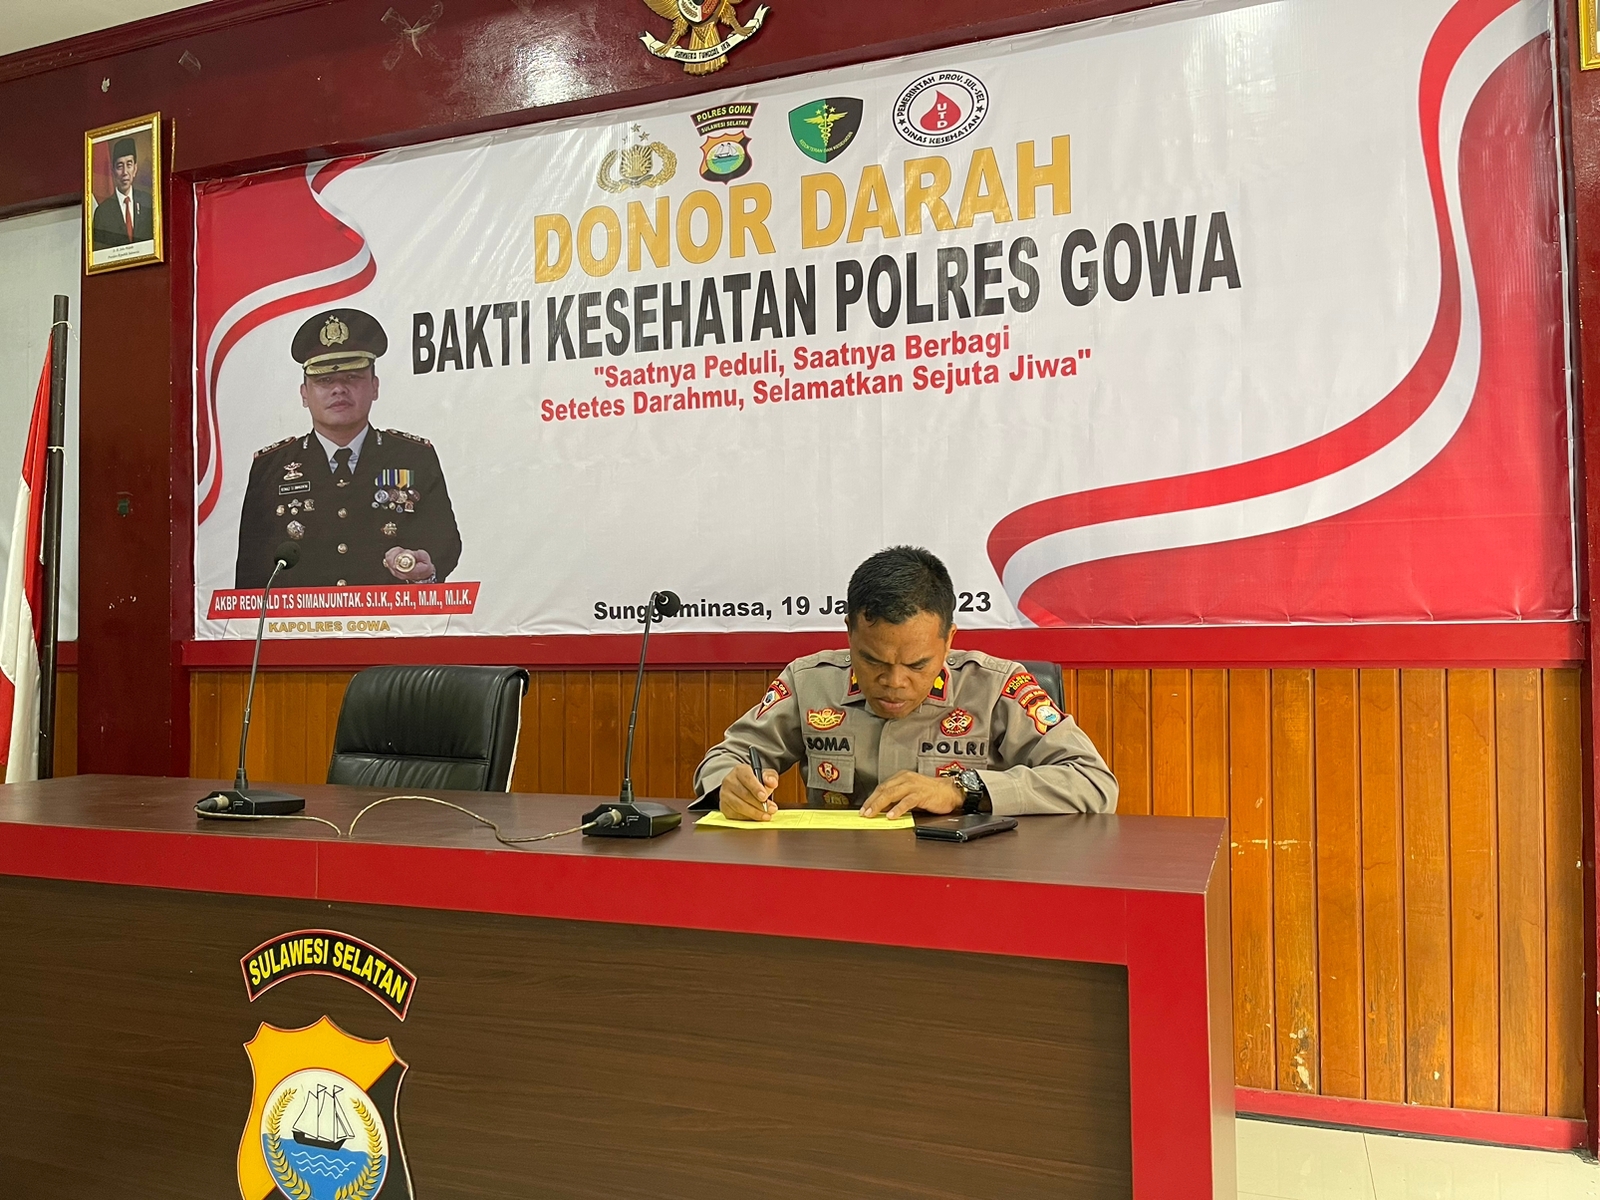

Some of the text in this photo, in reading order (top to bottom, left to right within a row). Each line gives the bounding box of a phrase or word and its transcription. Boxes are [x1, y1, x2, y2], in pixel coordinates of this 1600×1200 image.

[897, 73, 986, 117] PEMERINTAH PROV. SUL-SEL
[696, 105, 753, 122] POLRES GOWA
[701, 122, 727, 134] SULAWESI
[902, 115, 981, 145] DINAS KESEHATAN
[534, 134, 1072, 284] DONOR DARAH
[412, 211, 1242, 375] BAKTI KESEHATAN POLRES GOWA
[594, 325, 1010, 389] "Saatnya Peduli, Saatnya Berbagi
[541, 349, 1092, 422] Setetes Darahmu, Selamatkan Sejuta Jiwa"
[215, 596, 238, 612] AKBP
[281, 594, 295, 609] T.S
[296, 592, 365, 609] SIMANJUNTAK.
[395, 591, 417, 610] S.H.,
[418, 590, 443, 610] M.M.,
[445, 589, 472, 606] M.I.K.
[594, 599, 772, 624] Sunggminasa,
[781, 596, 810, 616] 19
[268, 620, 391, 633] KAPOLRES GOWA
[807, 737, 850, 752] SOMA
[921, 741, 985, 756] POLRI
[249, 938, 409, 1004] SULAWESI SELATAN
